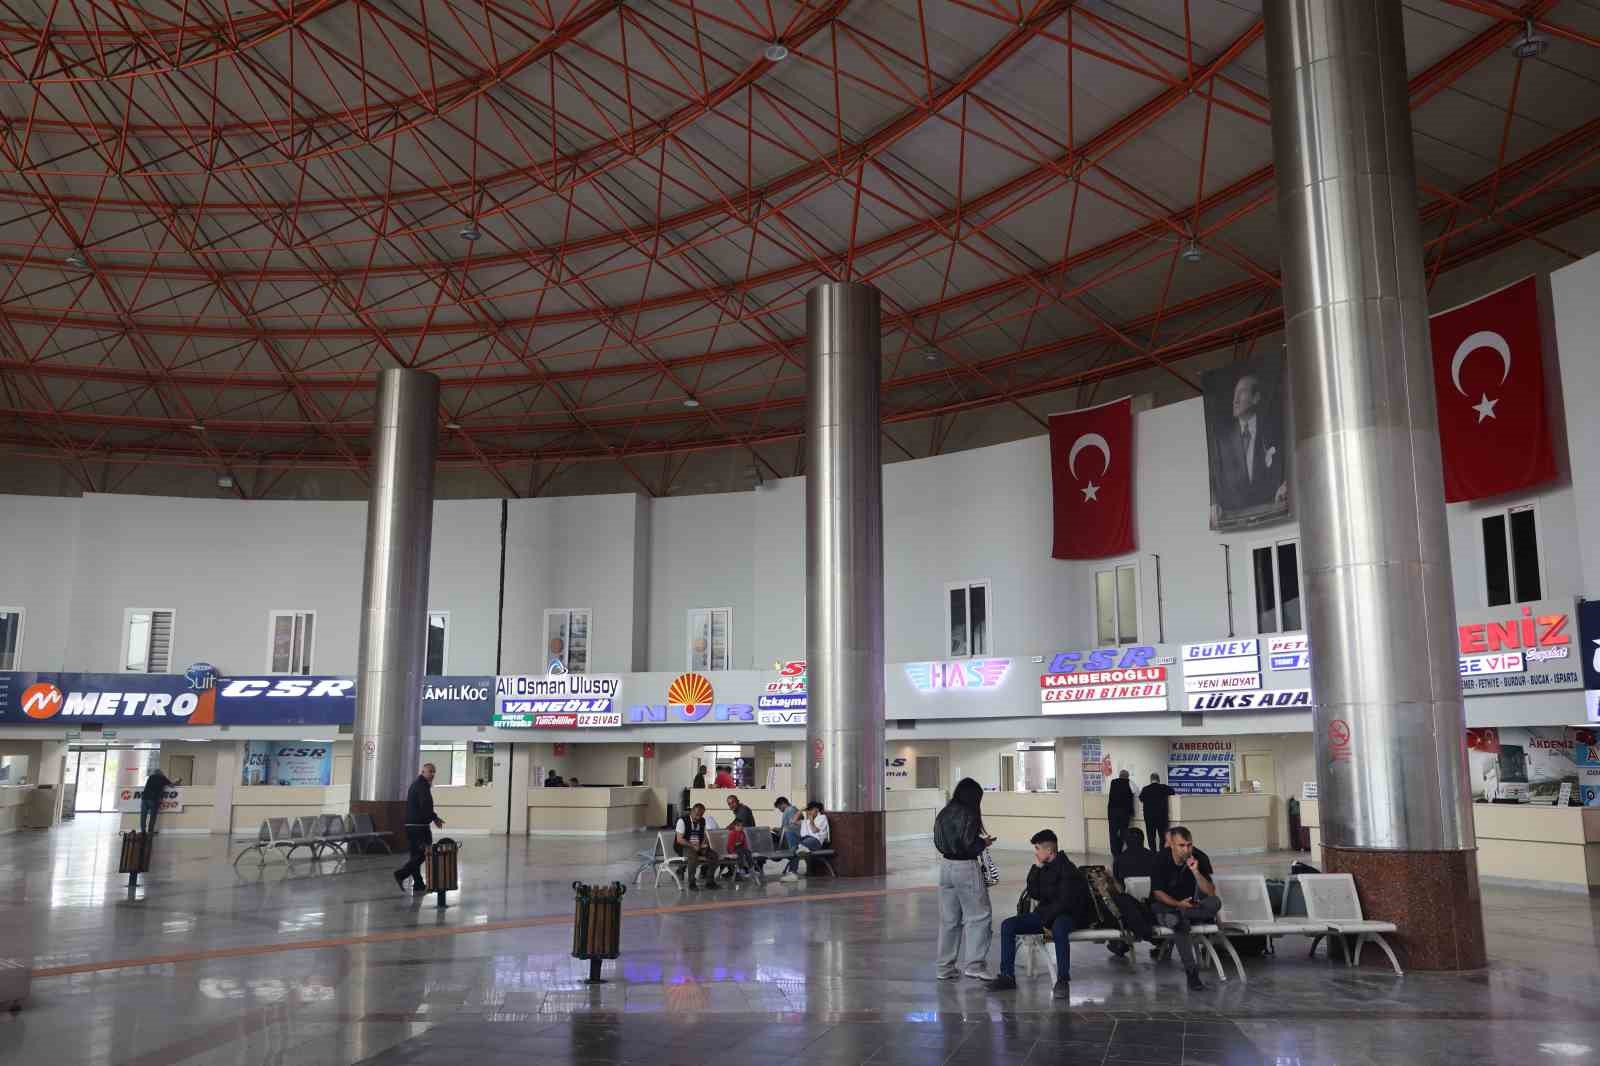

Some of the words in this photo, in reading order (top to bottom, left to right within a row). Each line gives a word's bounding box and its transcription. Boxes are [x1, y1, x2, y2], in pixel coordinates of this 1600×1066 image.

[1459, 607, 1569, 653] ENİZ
[1048, 646, 1156, 673] CSR
[931, 661, 984, 689] HAS
[221, 679, 354, 698] CSR
[496, 677, 513, 695] Ali
[517, 677, 566, 695] Osman
[570, 678, 619, 698] Ulusoy
[61, 692, 199, 717] METRO
[1194, 692, 1255, 710] LÜKS
[279, 748, 326, 757] CSR
[1168, 767, 1230, 777] CSR
